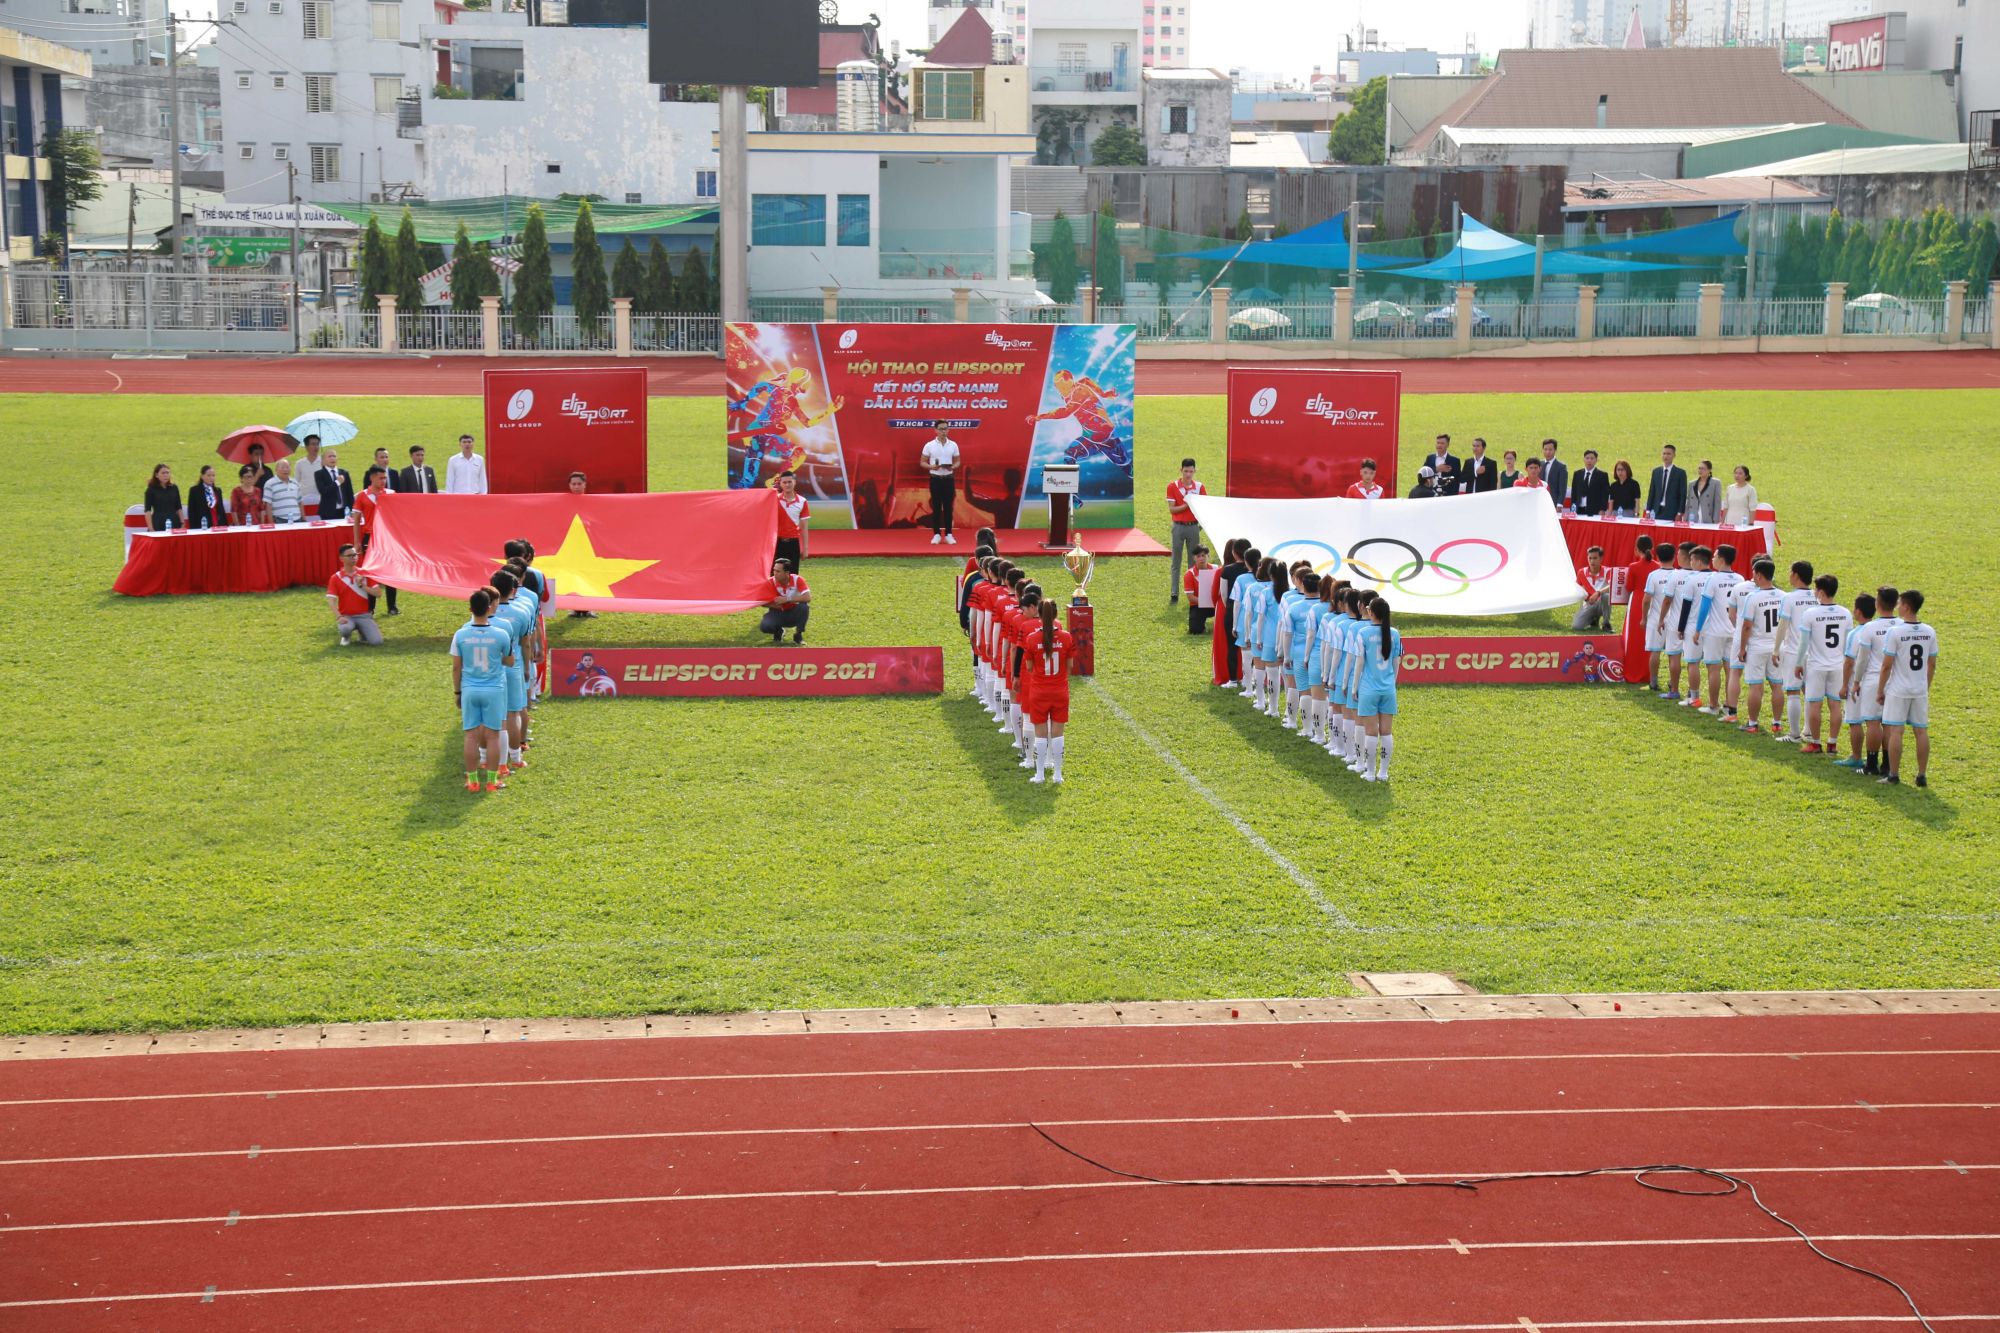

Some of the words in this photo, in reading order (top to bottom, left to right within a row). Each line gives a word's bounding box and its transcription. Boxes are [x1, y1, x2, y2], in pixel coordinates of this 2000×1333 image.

[252, 211, 272, 220] THAO
[275, 210, 284, 220] LÀ
[304, 210, 324, 221] XUÂN
[847, 359, 877, 377] HỘI
[881, 362, 929, 375] THAO
[933, 362, 1025, 375] ELIPSPORT
[873, 380, 899, 393] KẾT
[901, 380, 926, 393] NỐI
[928, 381, 956, 393] SỨC
[958, 383, 999, 396] MẠNH
[864, 395, 893, 409] DẪN
[896, 396, 919, 409] LỐI
[922, 397, 968, 409] THÀNH
[970, 397, 1008, 409] CÔNG
[1825, 624, 1839, 648] 5
[1455, 652, 1504, 670] CUP
[1509, 652, 1560, 669] 2021
[1909, 643, 1923, 671] 8
[624, 664, 762, 682] ELIPSPORT
[766, 663, 818, 681] CUP
[823, 662, 877, 680] 2021
